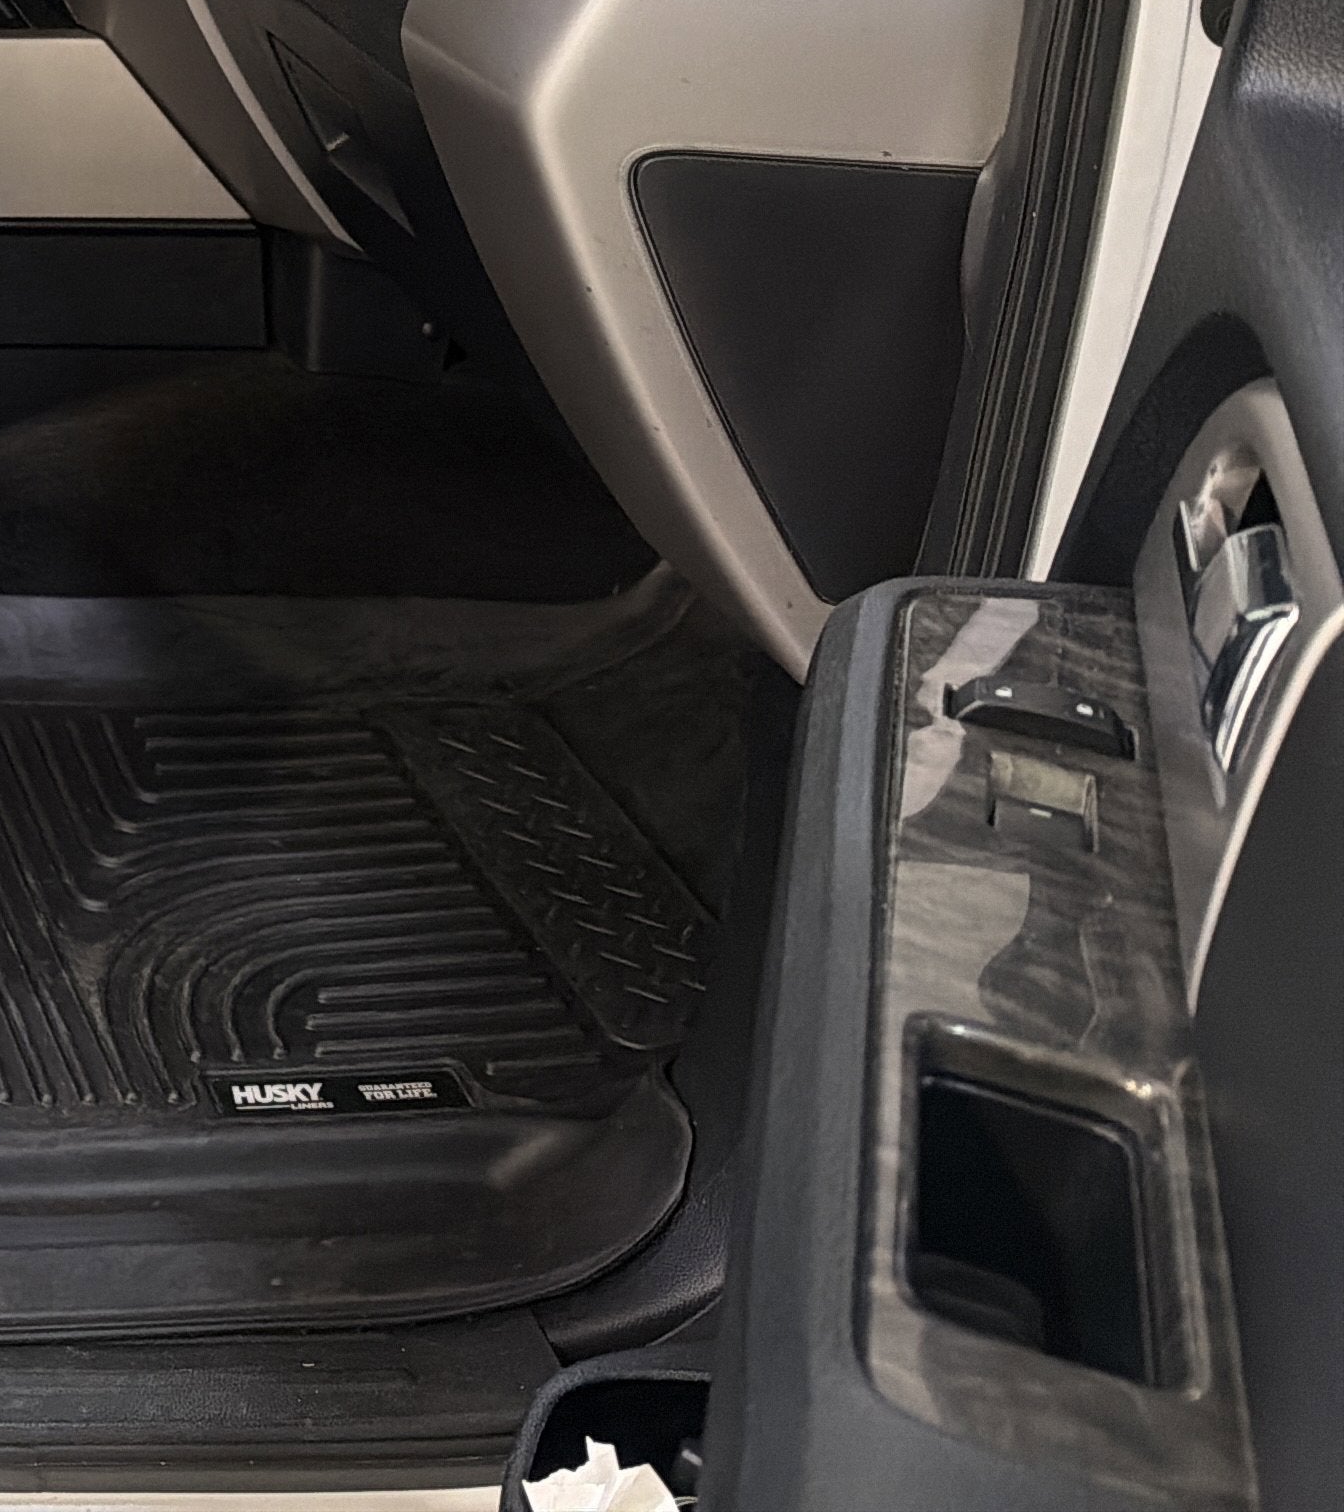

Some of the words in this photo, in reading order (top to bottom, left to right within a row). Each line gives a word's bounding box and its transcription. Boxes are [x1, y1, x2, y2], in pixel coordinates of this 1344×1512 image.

[358, 1081, 433, 1092] GUARANTEED
[231, 1082, 323, 1105] HUSKY
[364, 1089, 396, 1101] FOR
[290, 1101, 335, 1111] LINERS
